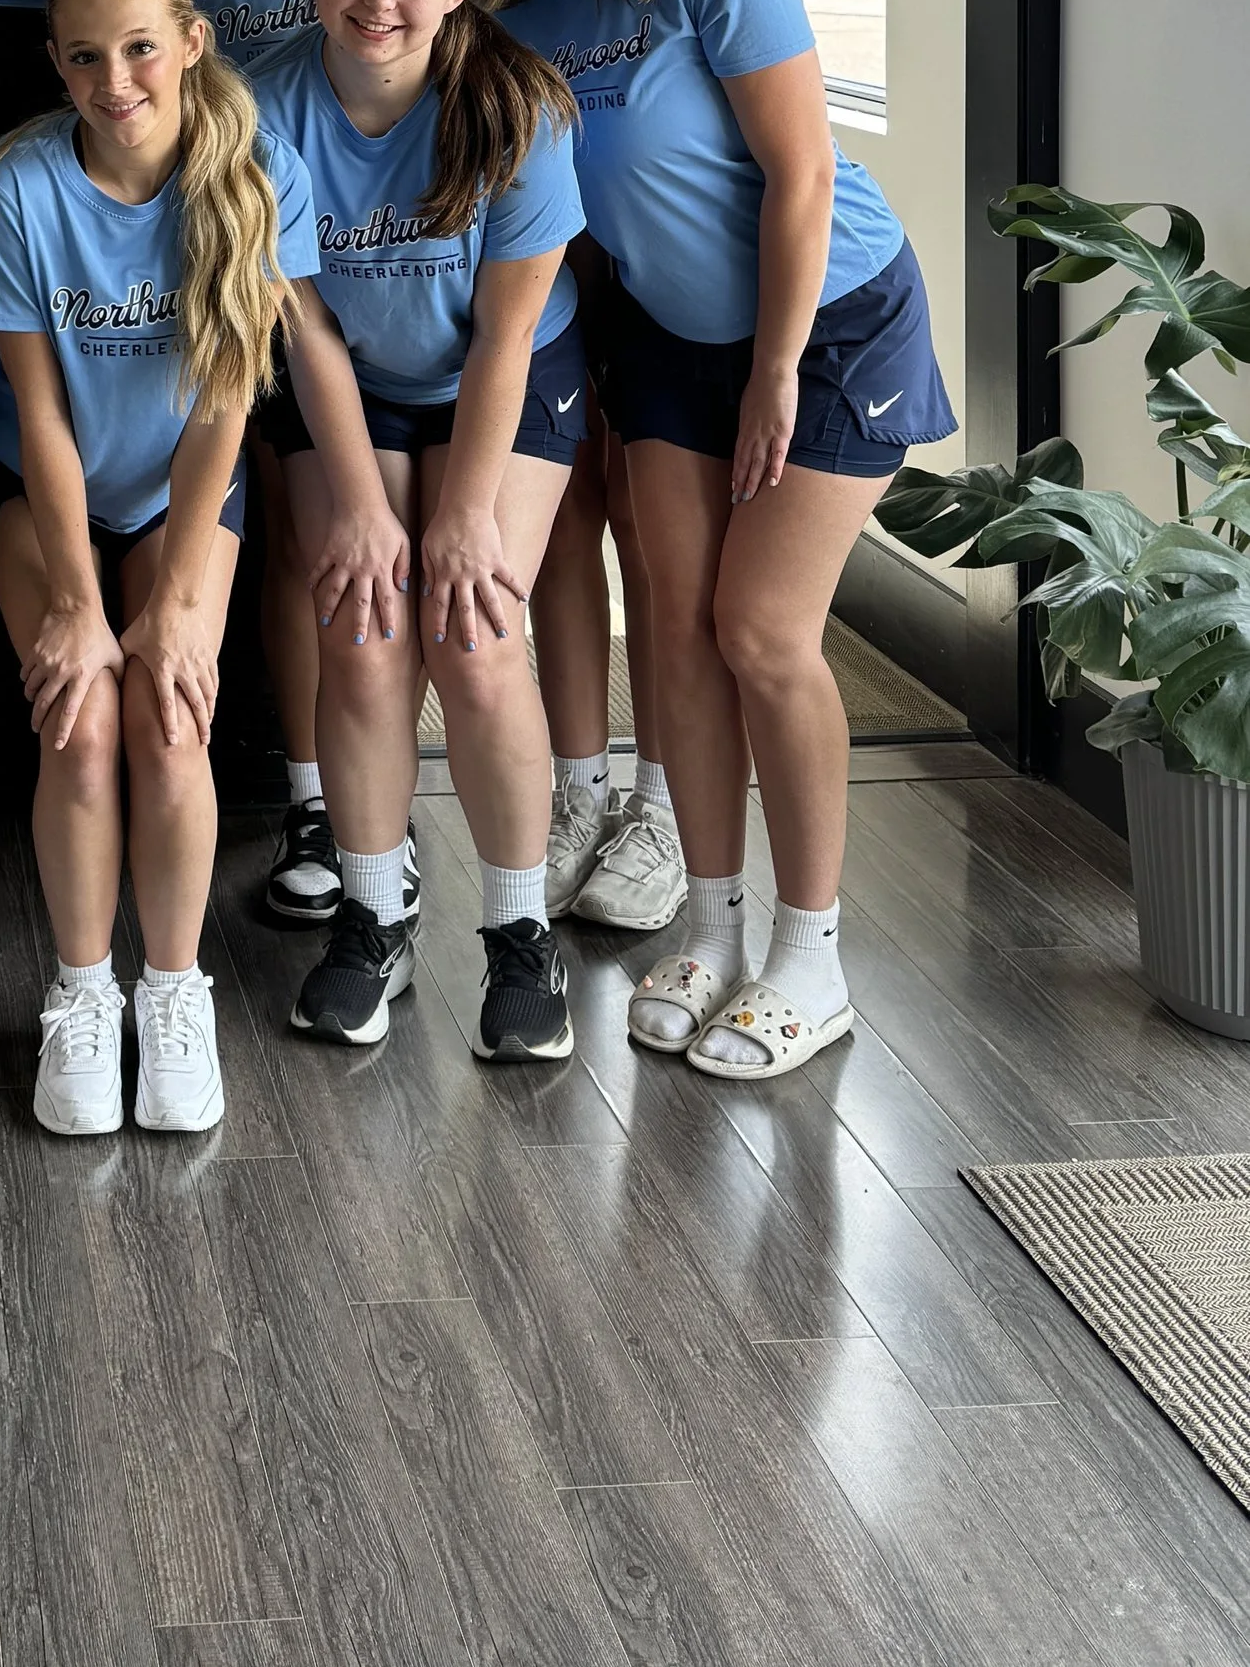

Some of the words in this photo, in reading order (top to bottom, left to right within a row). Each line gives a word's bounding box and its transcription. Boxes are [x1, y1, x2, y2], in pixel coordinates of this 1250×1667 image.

[551, 14, 653, 81] thwood
[329, 258, 467, 280] CHEERLEADING
[51, 279, 181, 333] Northw
[80, 341, 169, 357] CHEERLE
